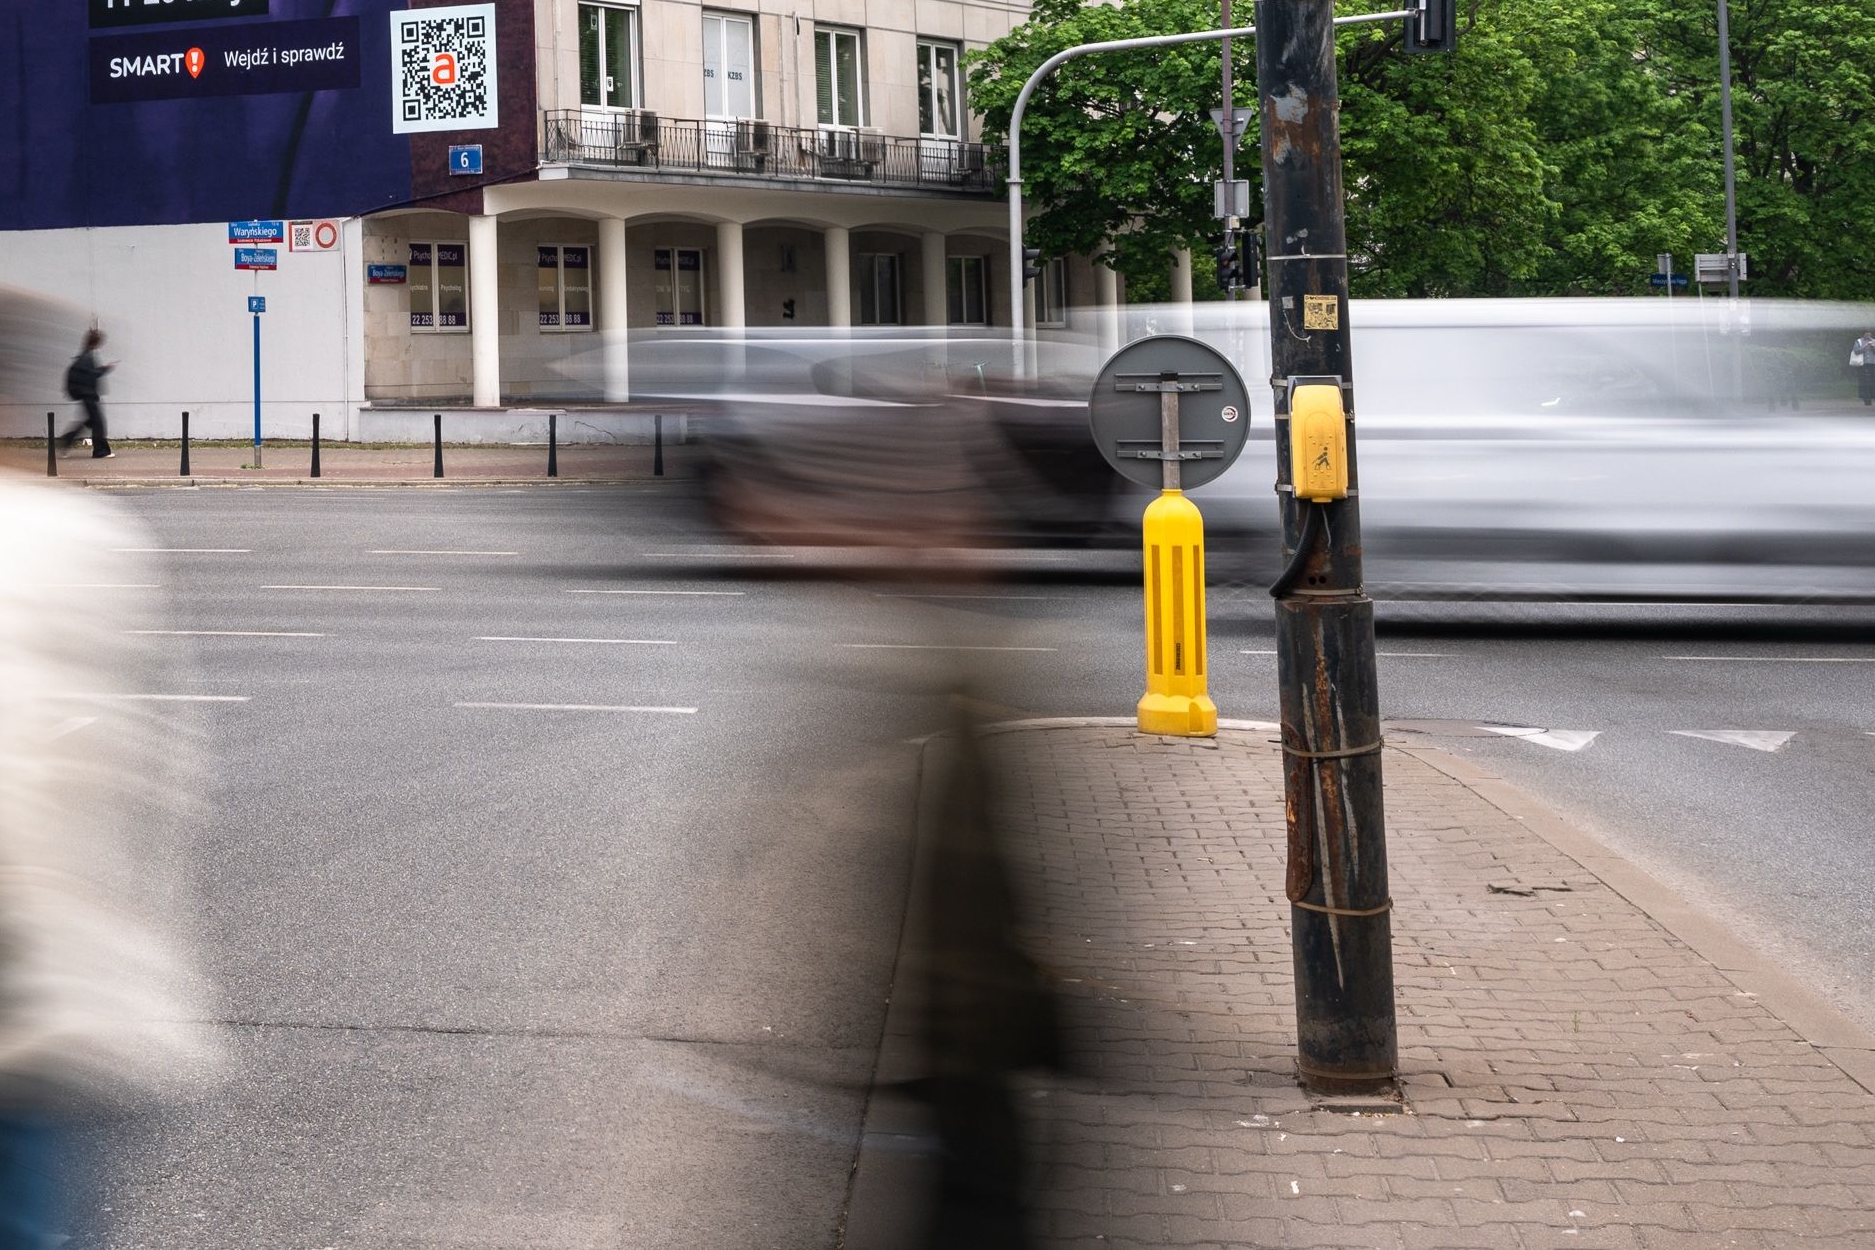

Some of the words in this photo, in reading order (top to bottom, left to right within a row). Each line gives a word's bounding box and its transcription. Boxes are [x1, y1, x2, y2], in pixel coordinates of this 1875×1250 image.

[225, 47, 270, 71] Wejdź
[273, 49, 277, 64] i
[281, 42, 345, 67] sprawdź
[432, 53, 455, 85] a
[727, 71, 743, 81] KZBS
[460, 151, 469, 168] 6
[233, 226, 278, 238] Waryńskiego
